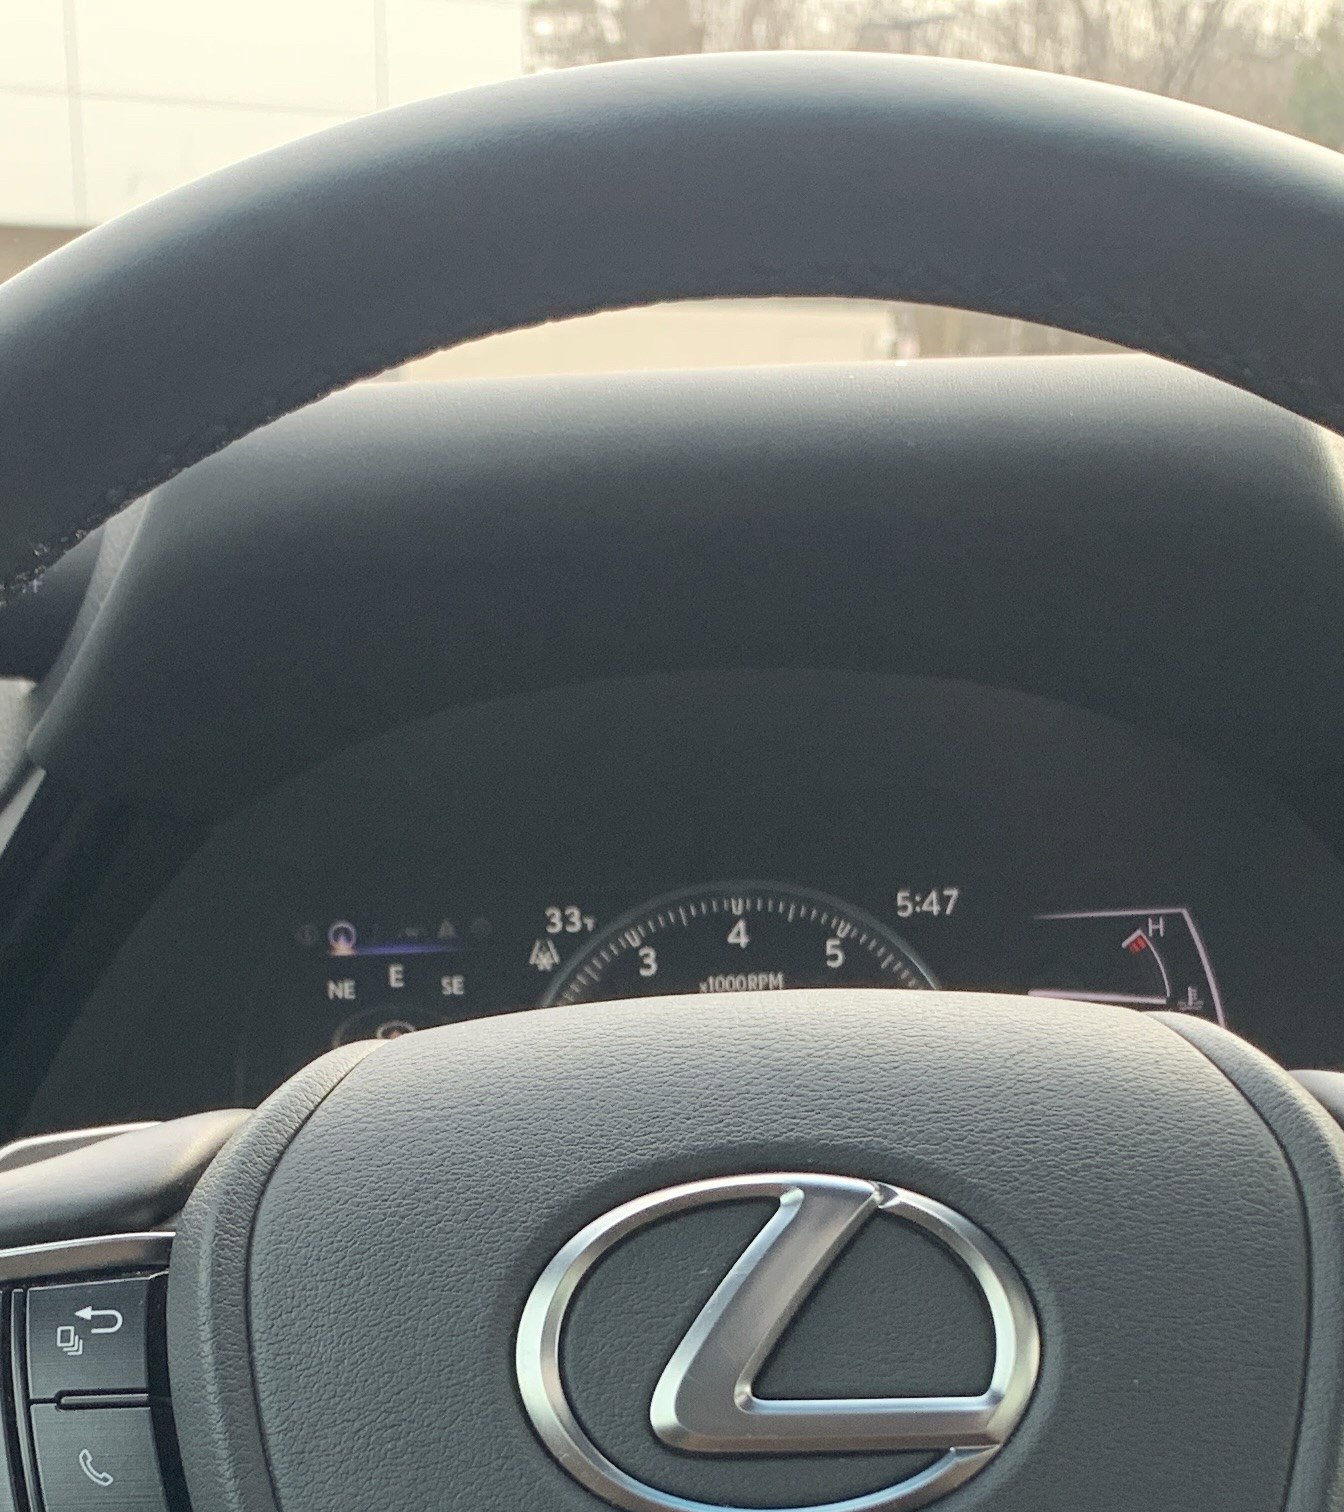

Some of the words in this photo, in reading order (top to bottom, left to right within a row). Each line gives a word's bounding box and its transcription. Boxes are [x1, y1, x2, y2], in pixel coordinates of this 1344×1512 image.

[895, 887, 960, 918] 5:47
[726, 918, 750, 949] 4
[1147, 916, 1164, 938] H
[637, 945, 658, 978] 3
[825, 937, 845, 969] 5
[327, 979, 356, 1000] NE
[388, 964, 404, 988] E
[440, 975, 464, 995] SE
